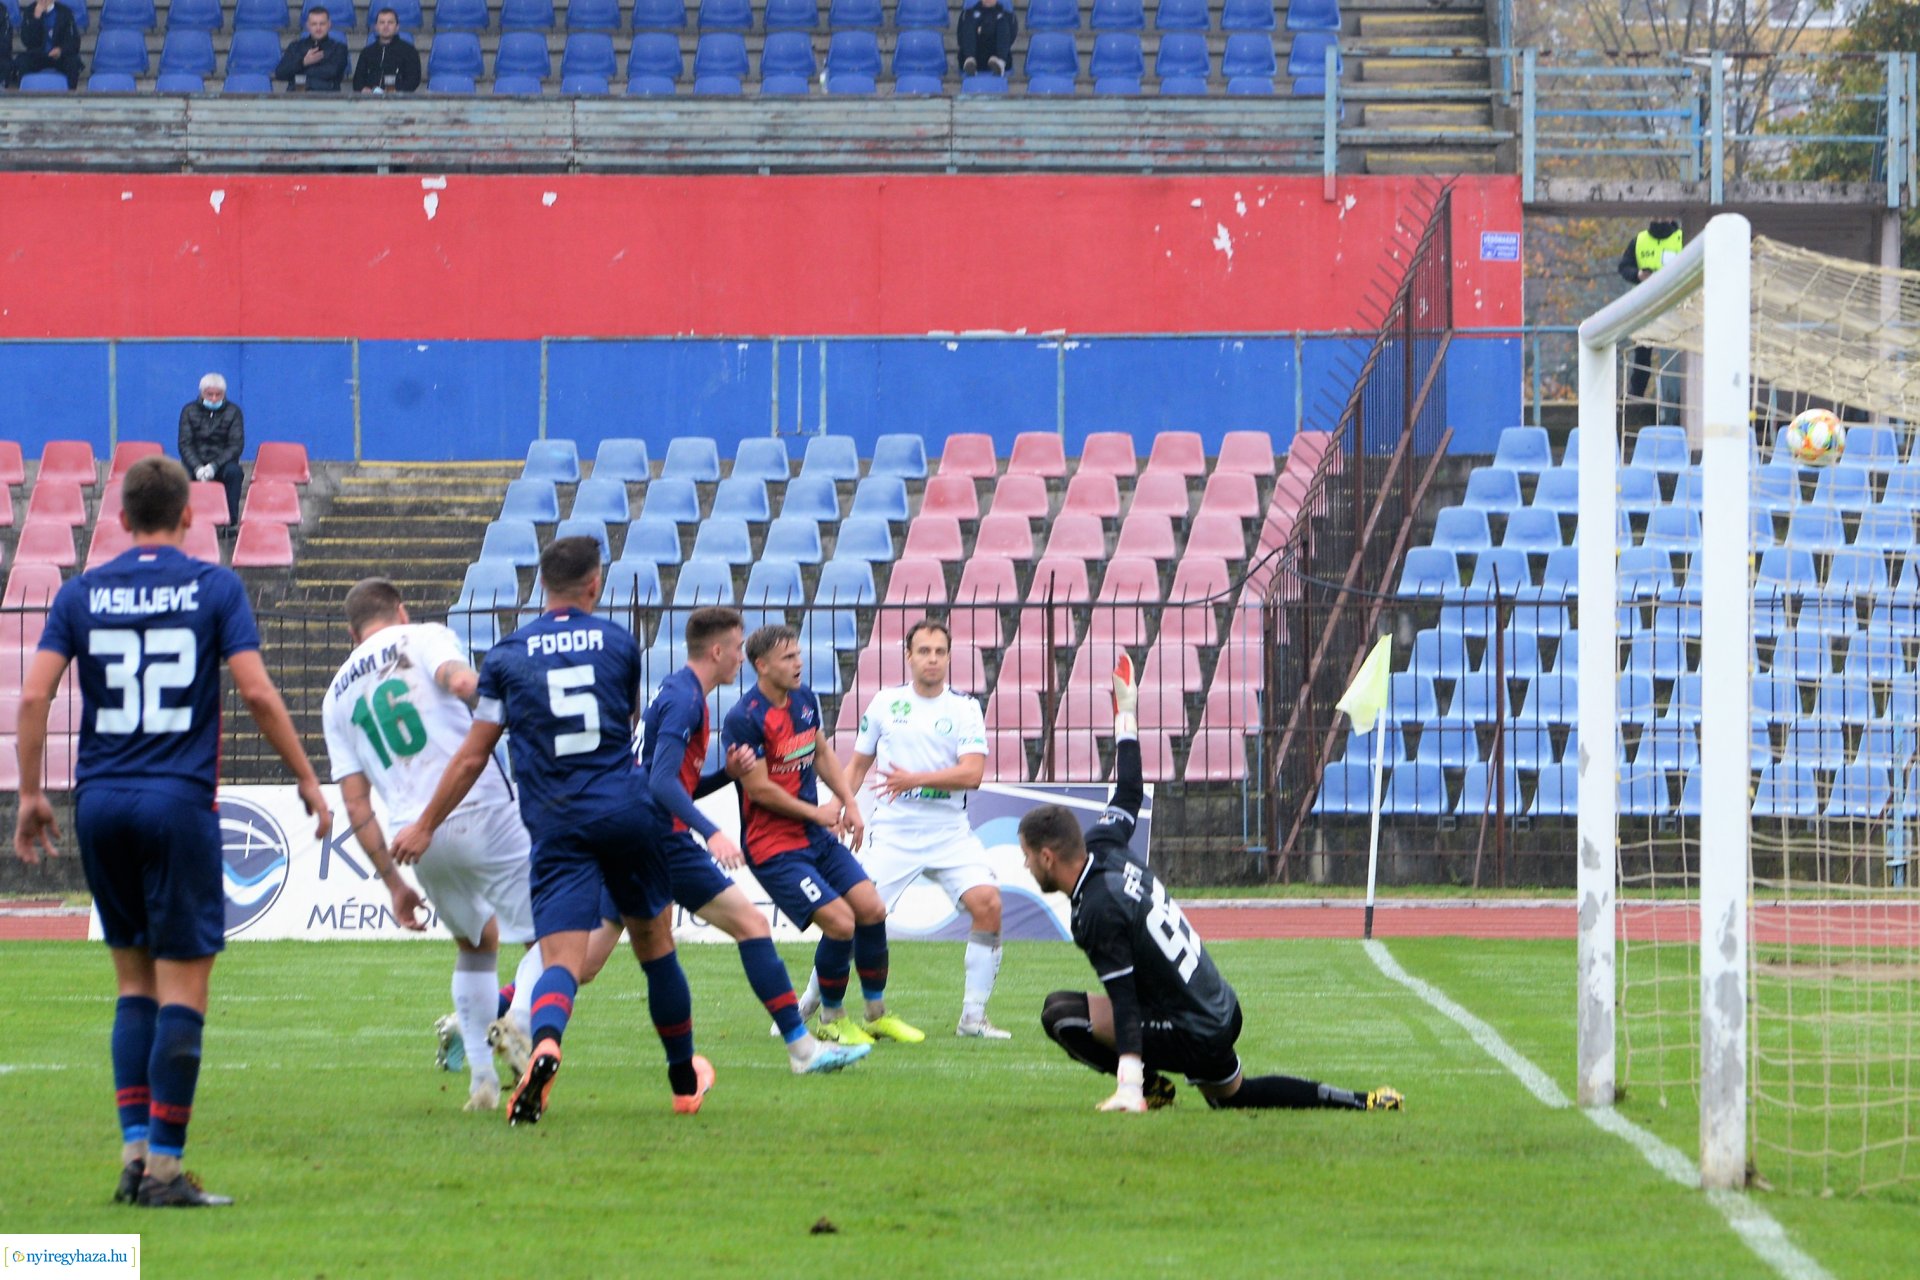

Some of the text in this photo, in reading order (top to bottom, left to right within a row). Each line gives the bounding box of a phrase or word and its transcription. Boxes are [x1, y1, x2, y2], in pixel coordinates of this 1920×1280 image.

[88, 627, 198, 734] 32
[527, 629, 604, 657] FODOR
[351, 678, 428, 770] 16
[546, 664, 602, 757] 5
[799, 876, 823, 903] 6
